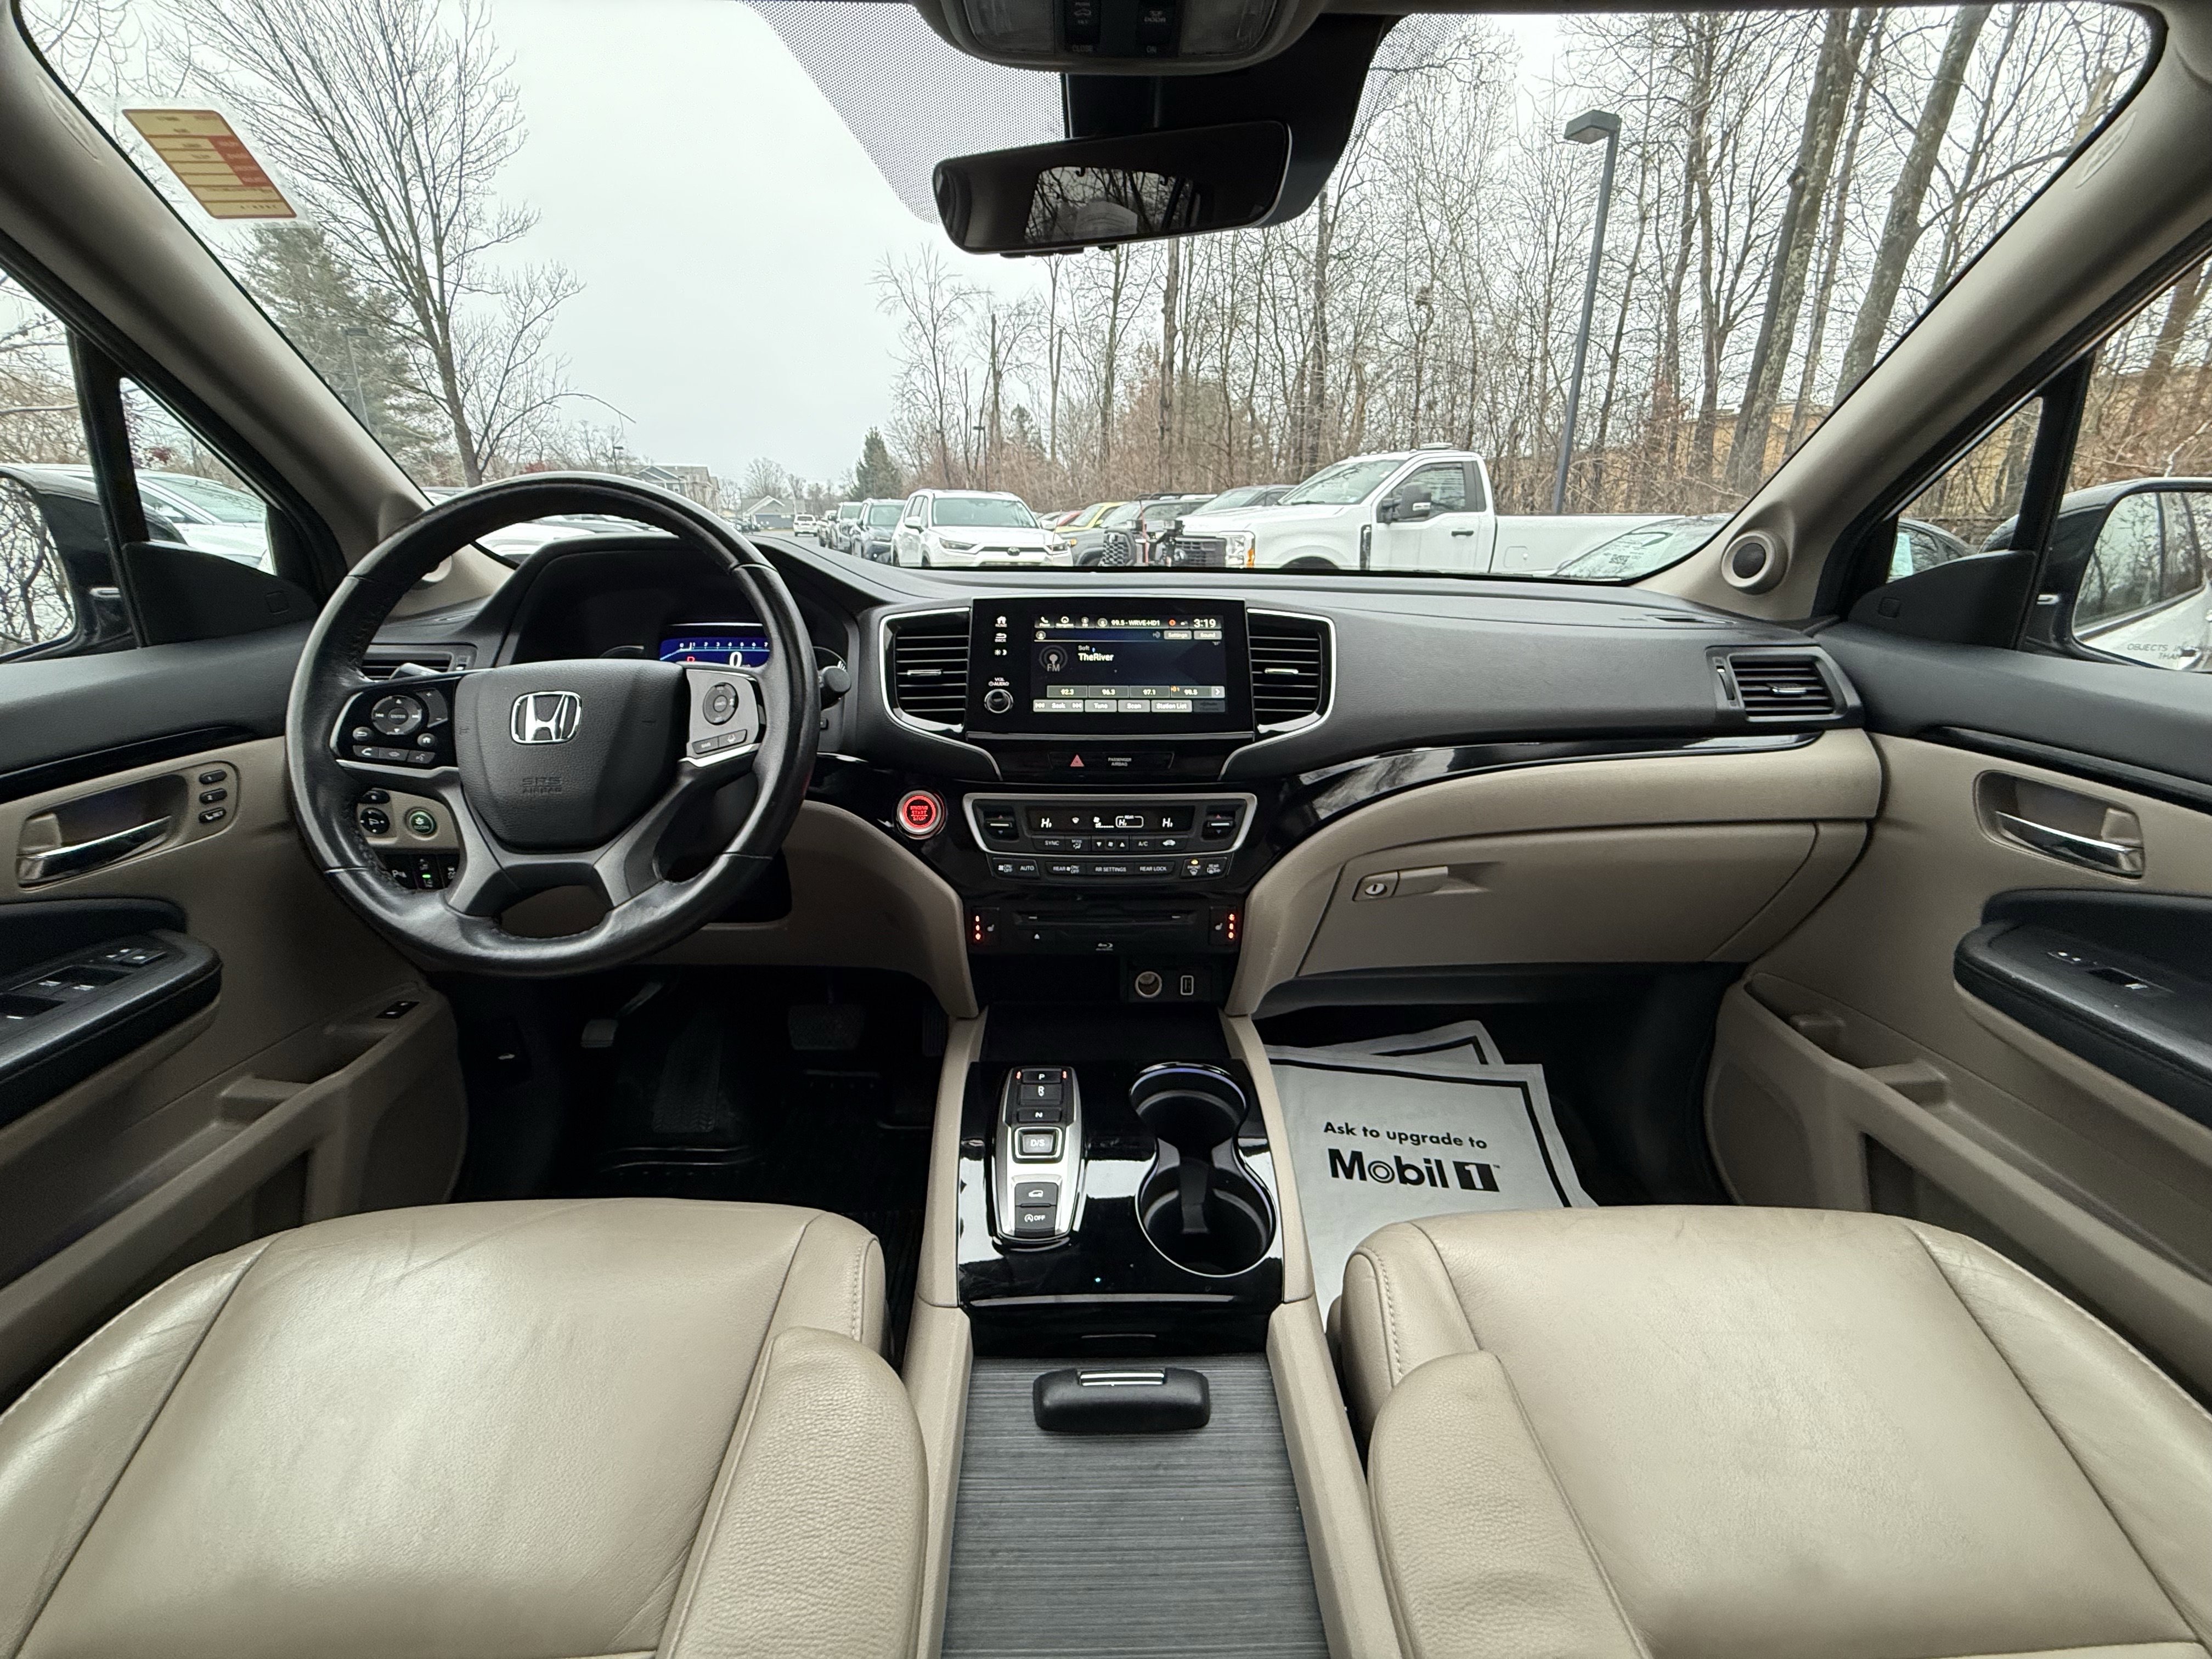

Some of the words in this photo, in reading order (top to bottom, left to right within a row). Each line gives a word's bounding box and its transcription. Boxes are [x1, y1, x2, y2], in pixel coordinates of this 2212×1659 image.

[1193, 618, 1216, 628] 3:19
[2127, 643, 2168, 652] OBJECTS
[730, 651, 742, 668] 0
[1078, 653, 1114, 661] TheRiver
[1323, 1121, 1357, 1136] Ask
[1362, 1126, 1380, 1138] to
[1386, 1130, 1463, 1146] upgrade
[1468, 1137, 1487, 1149] to
[1030, 1139, 1045, 1147] D/S
[1327, 1148, 1450, 1188] Mobil
